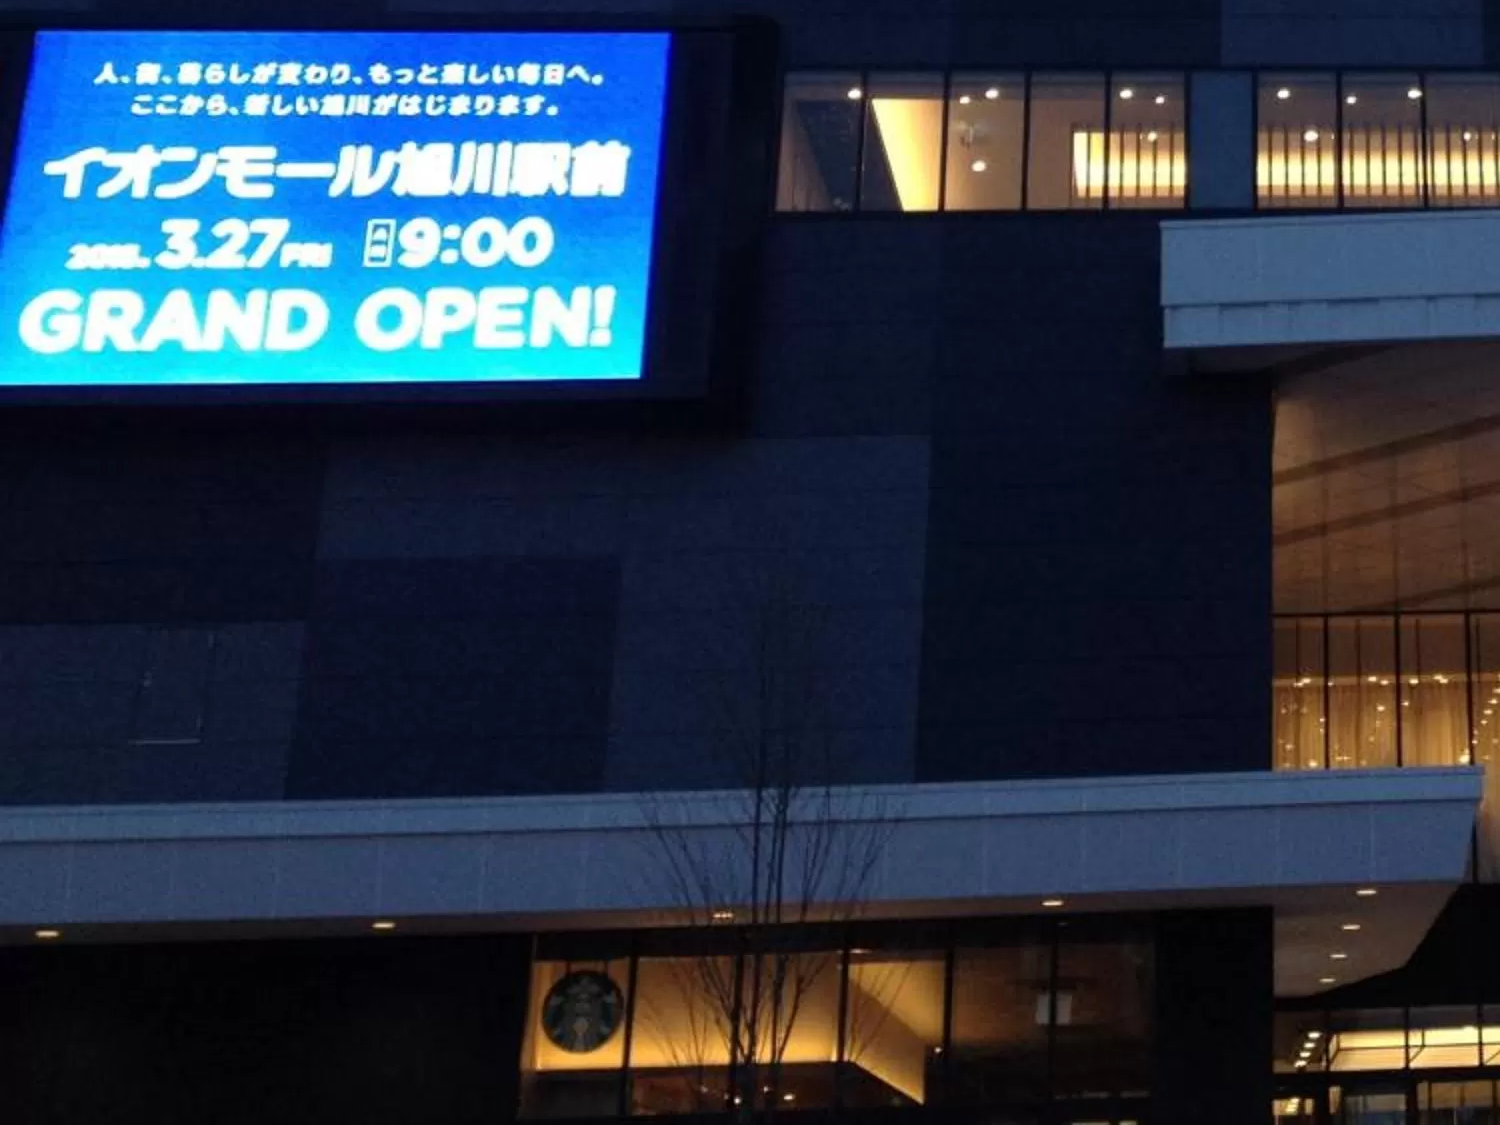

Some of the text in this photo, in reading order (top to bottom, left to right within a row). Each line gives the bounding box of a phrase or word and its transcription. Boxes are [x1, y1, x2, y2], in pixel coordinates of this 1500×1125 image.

[397, 216, 555, 268] 9:00
[18, 285, 617, 354] GRAND OPEN!
